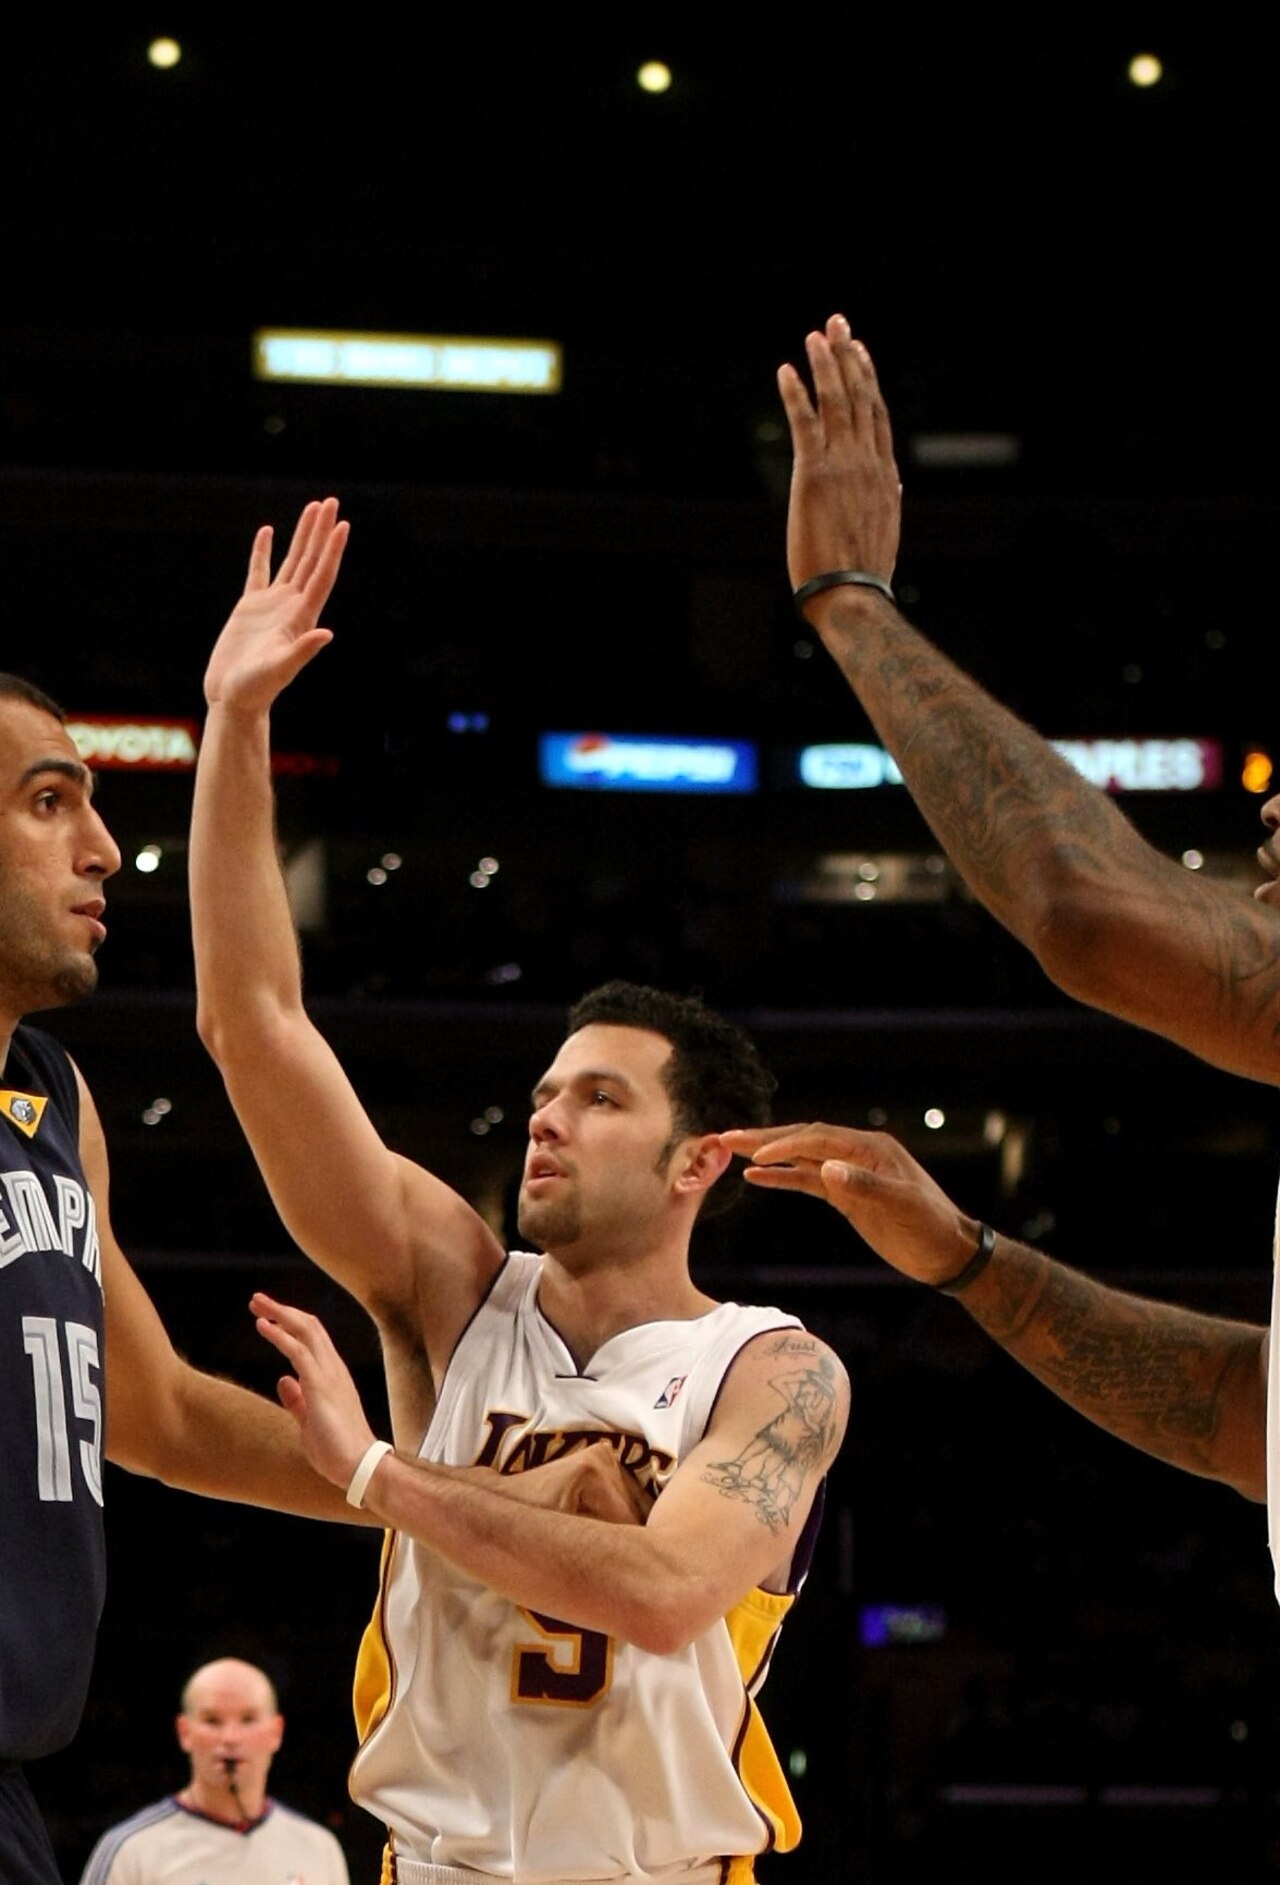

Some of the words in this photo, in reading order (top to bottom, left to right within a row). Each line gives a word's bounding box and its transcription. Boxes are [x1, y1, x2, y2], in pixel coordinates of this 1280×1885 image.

[65, 721, 198, 765] OYOTA
[1046, 737, 1205, 791] APLES
[21, 1316, 104, 1507] 15
